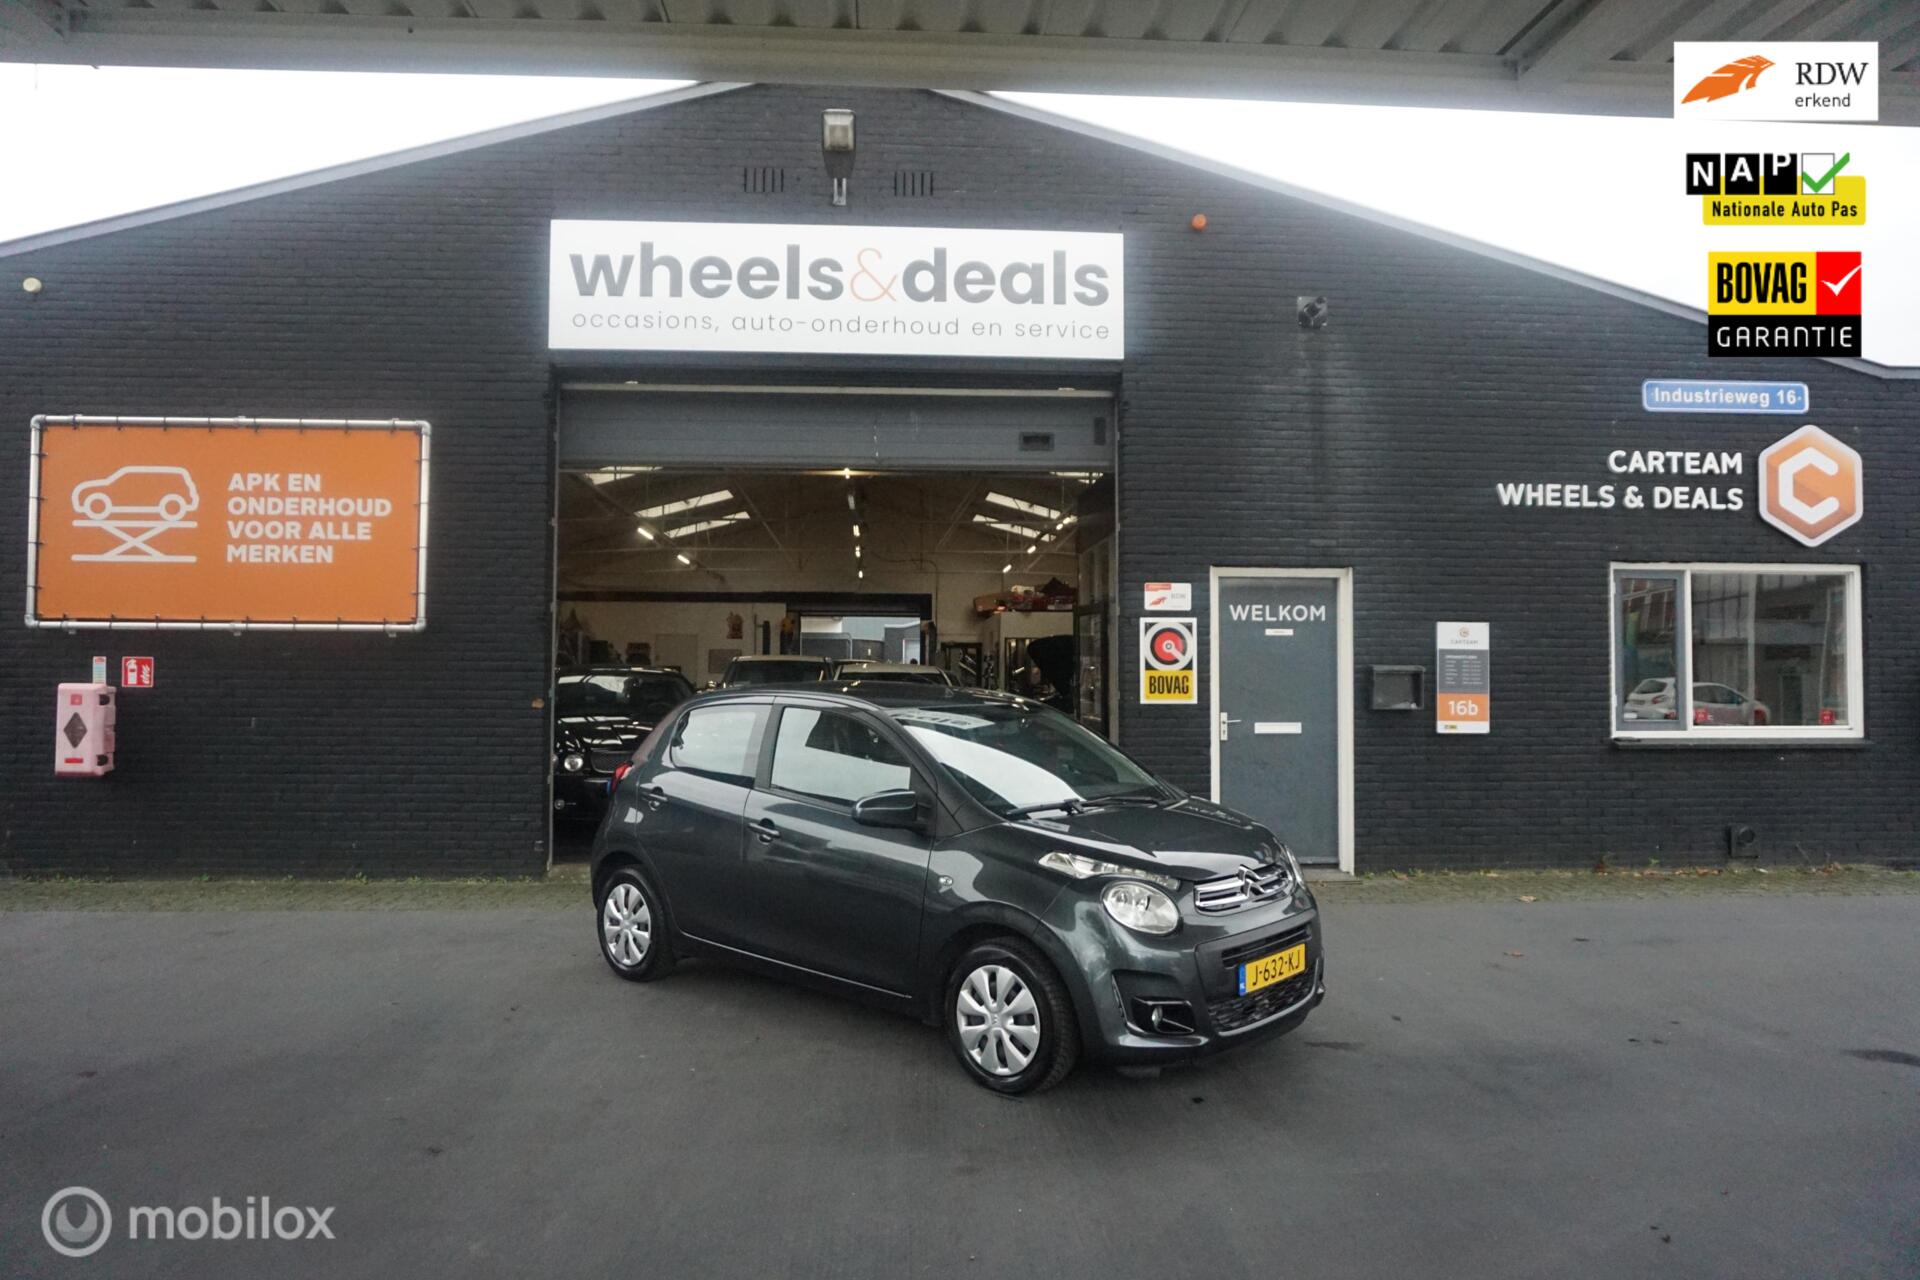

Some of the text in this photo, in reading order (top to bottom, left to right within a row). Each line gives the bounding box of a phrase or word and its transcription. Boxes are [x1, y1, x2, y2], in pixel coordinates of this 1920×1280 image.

[569, 241, 1110, 307] wheels&deals
[572, 310, 1110, 340] occasions, auto-onderhoud en service
[1654, 386, 1797, 407] Industrieweg 16
[1608, 450, 1743, 475] CARTEAM
[228, 473, 321, 492] APK EN
[1496, 482, 1744, 511] WHEELS & DEALS
[227, 497, 392, 517] ONDERHOUD
[227, 521, 372, 541] VOOR ALLE
[226, 544, 334, 564] MERKEN
[1229, 604, 1326, 621] WELKOM
[1148, 675, 1190, 695] BOVAG
[1448, 699, 1479, 716] 16b
[1252, 949, 1301, 987] J-632-KJ
